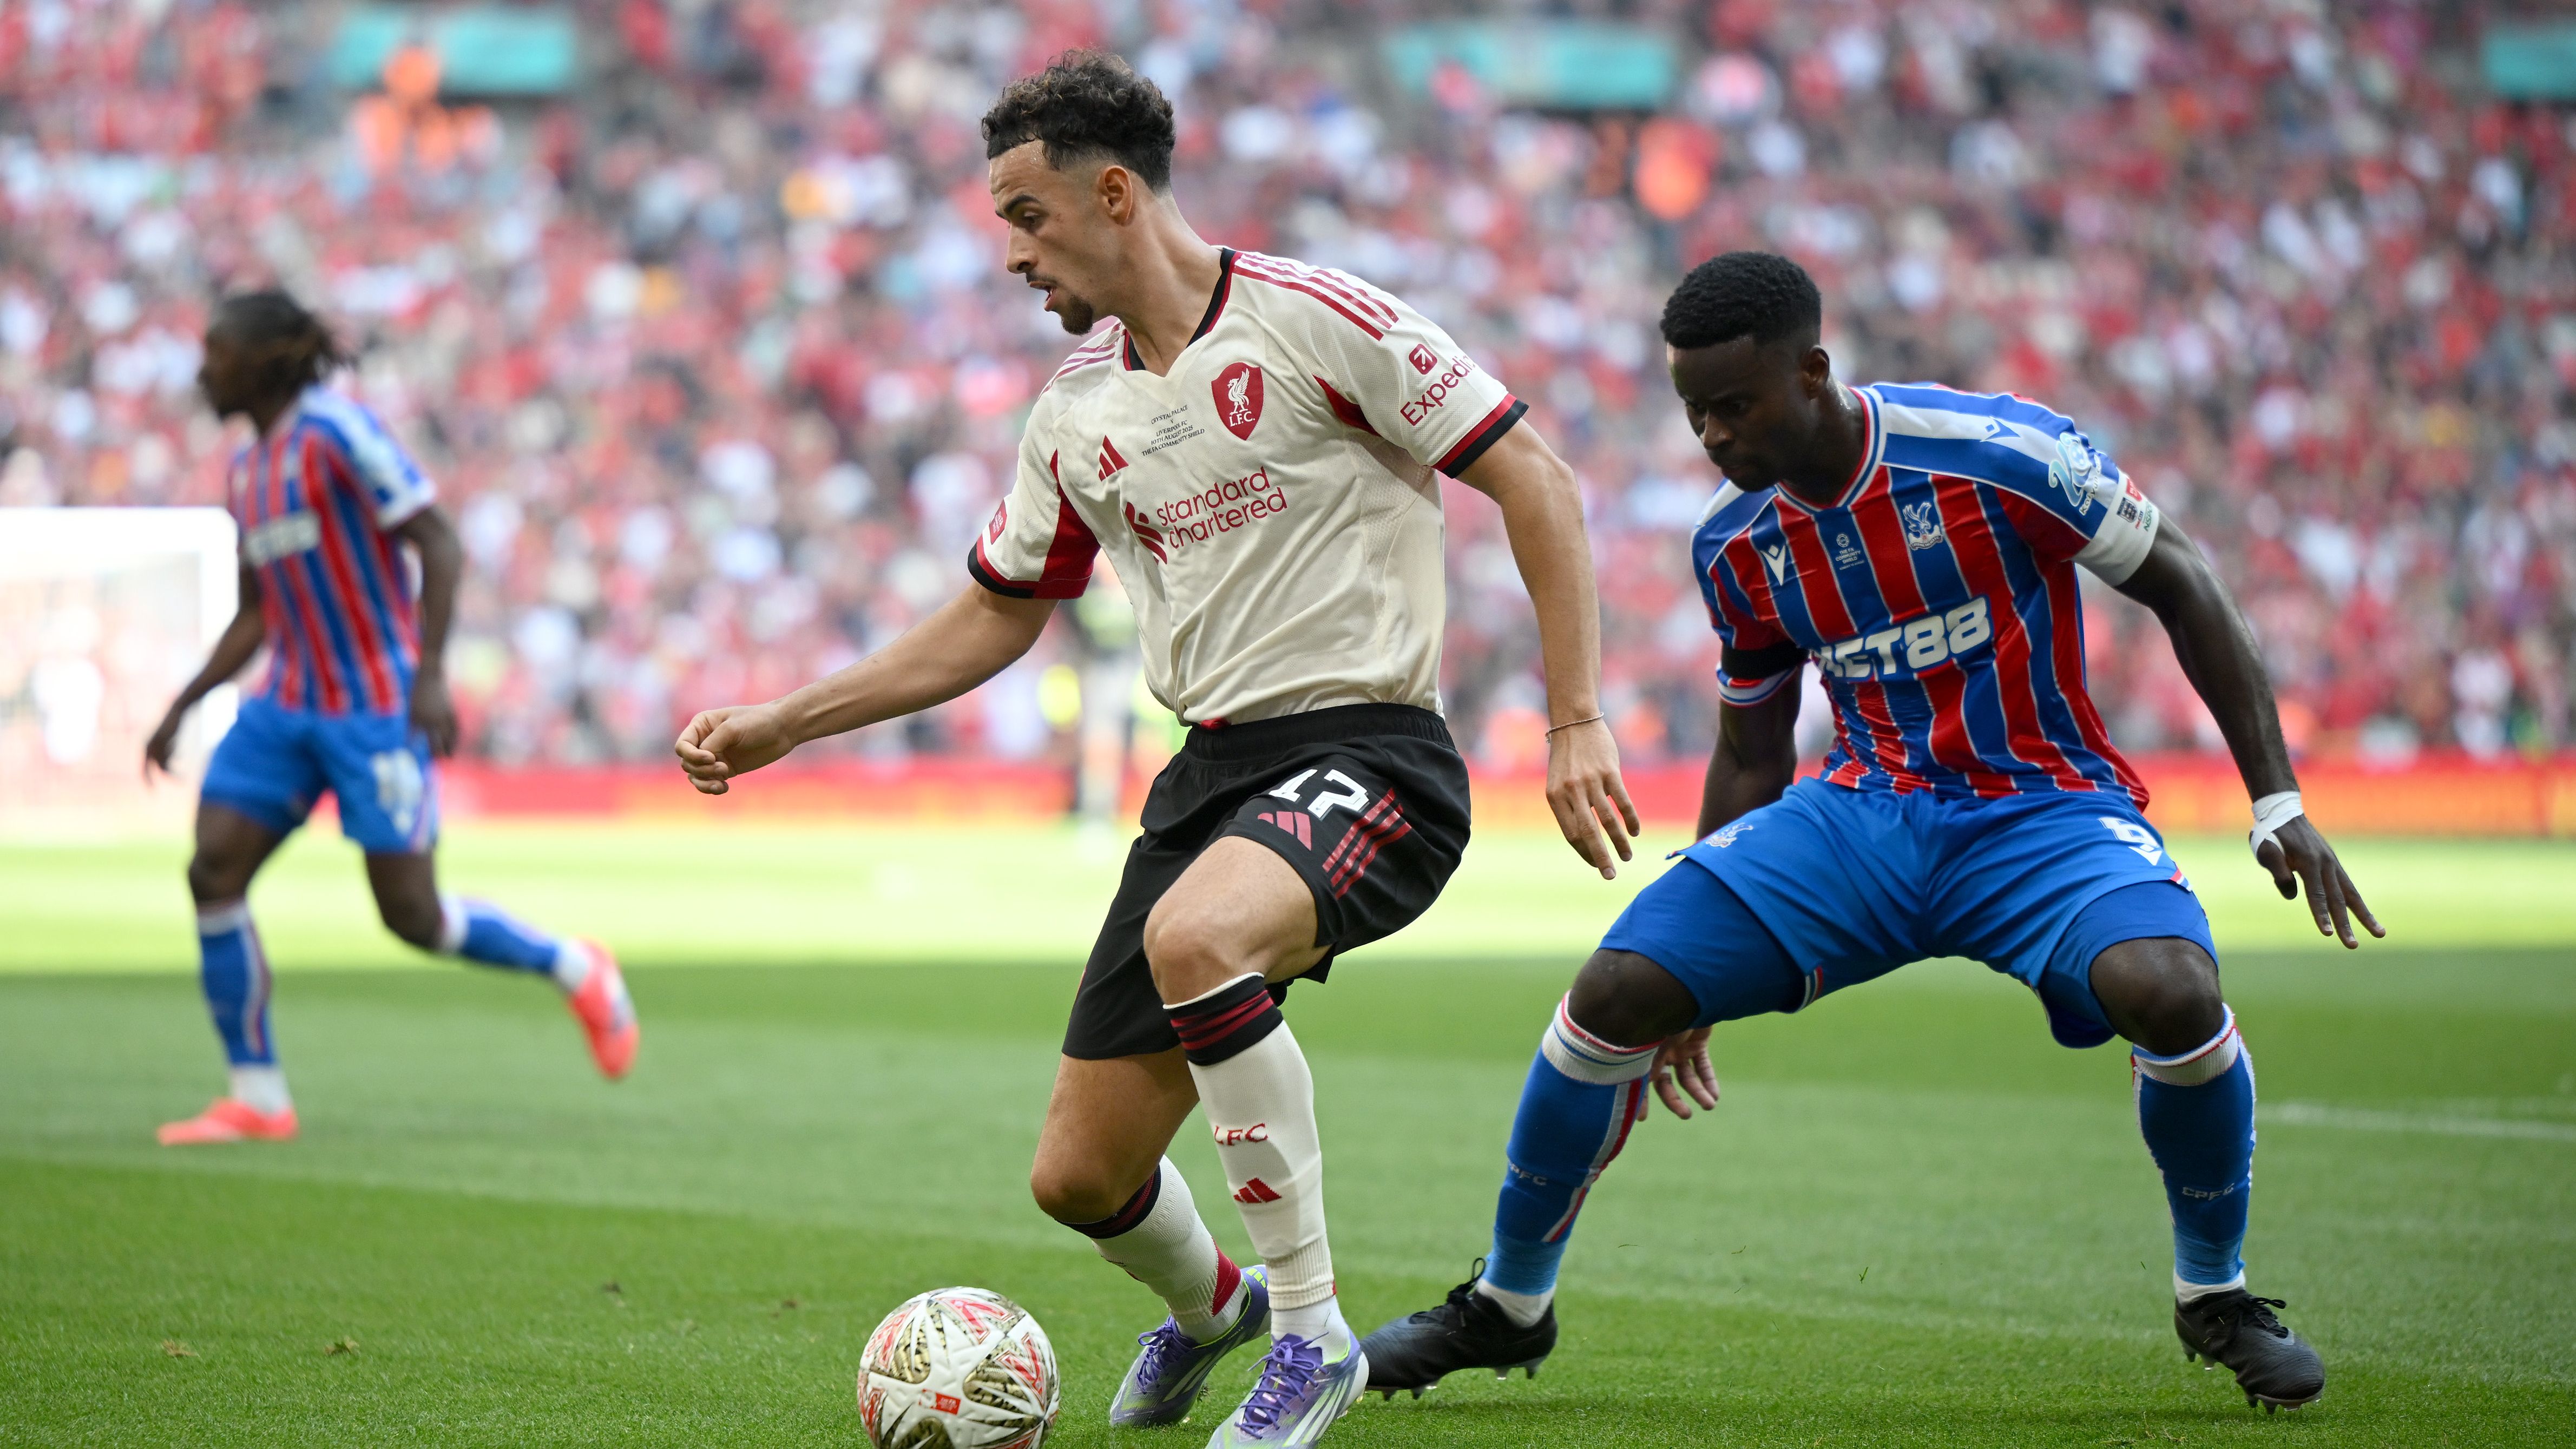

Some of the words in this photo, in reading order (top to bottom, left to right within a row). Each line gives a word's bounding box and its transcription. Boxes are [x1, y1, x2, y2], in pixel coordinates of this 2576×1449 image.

[1151, 413, 1172, 425] CRYSTAL
[1172, 405, 1188, 416] PALACE
[1229, 411, 1256, 427] L.F.C.
[1151, 437, 1163, 445] 10TH
[1164, 430, 1181, 440] AUGUST
[1182, 425, 1193, 433] 2025
[1156, 423, 1181, 437] LIVERPOOL
[1142, 448, 1152, 456] THE
[1158, 434, 1187, 450] COMMUNITY
[1187, 429, 1205, 439] SHIELD
[1156, 466, 1271, 526] standard
[1169, 487, 1287, 549] chartered
[1835, 550, 1861, 562] COMMUNITY
[1214, 1123, 1268, 1147] LFC
[2182, 1182, 2235, 1201] CPFC
